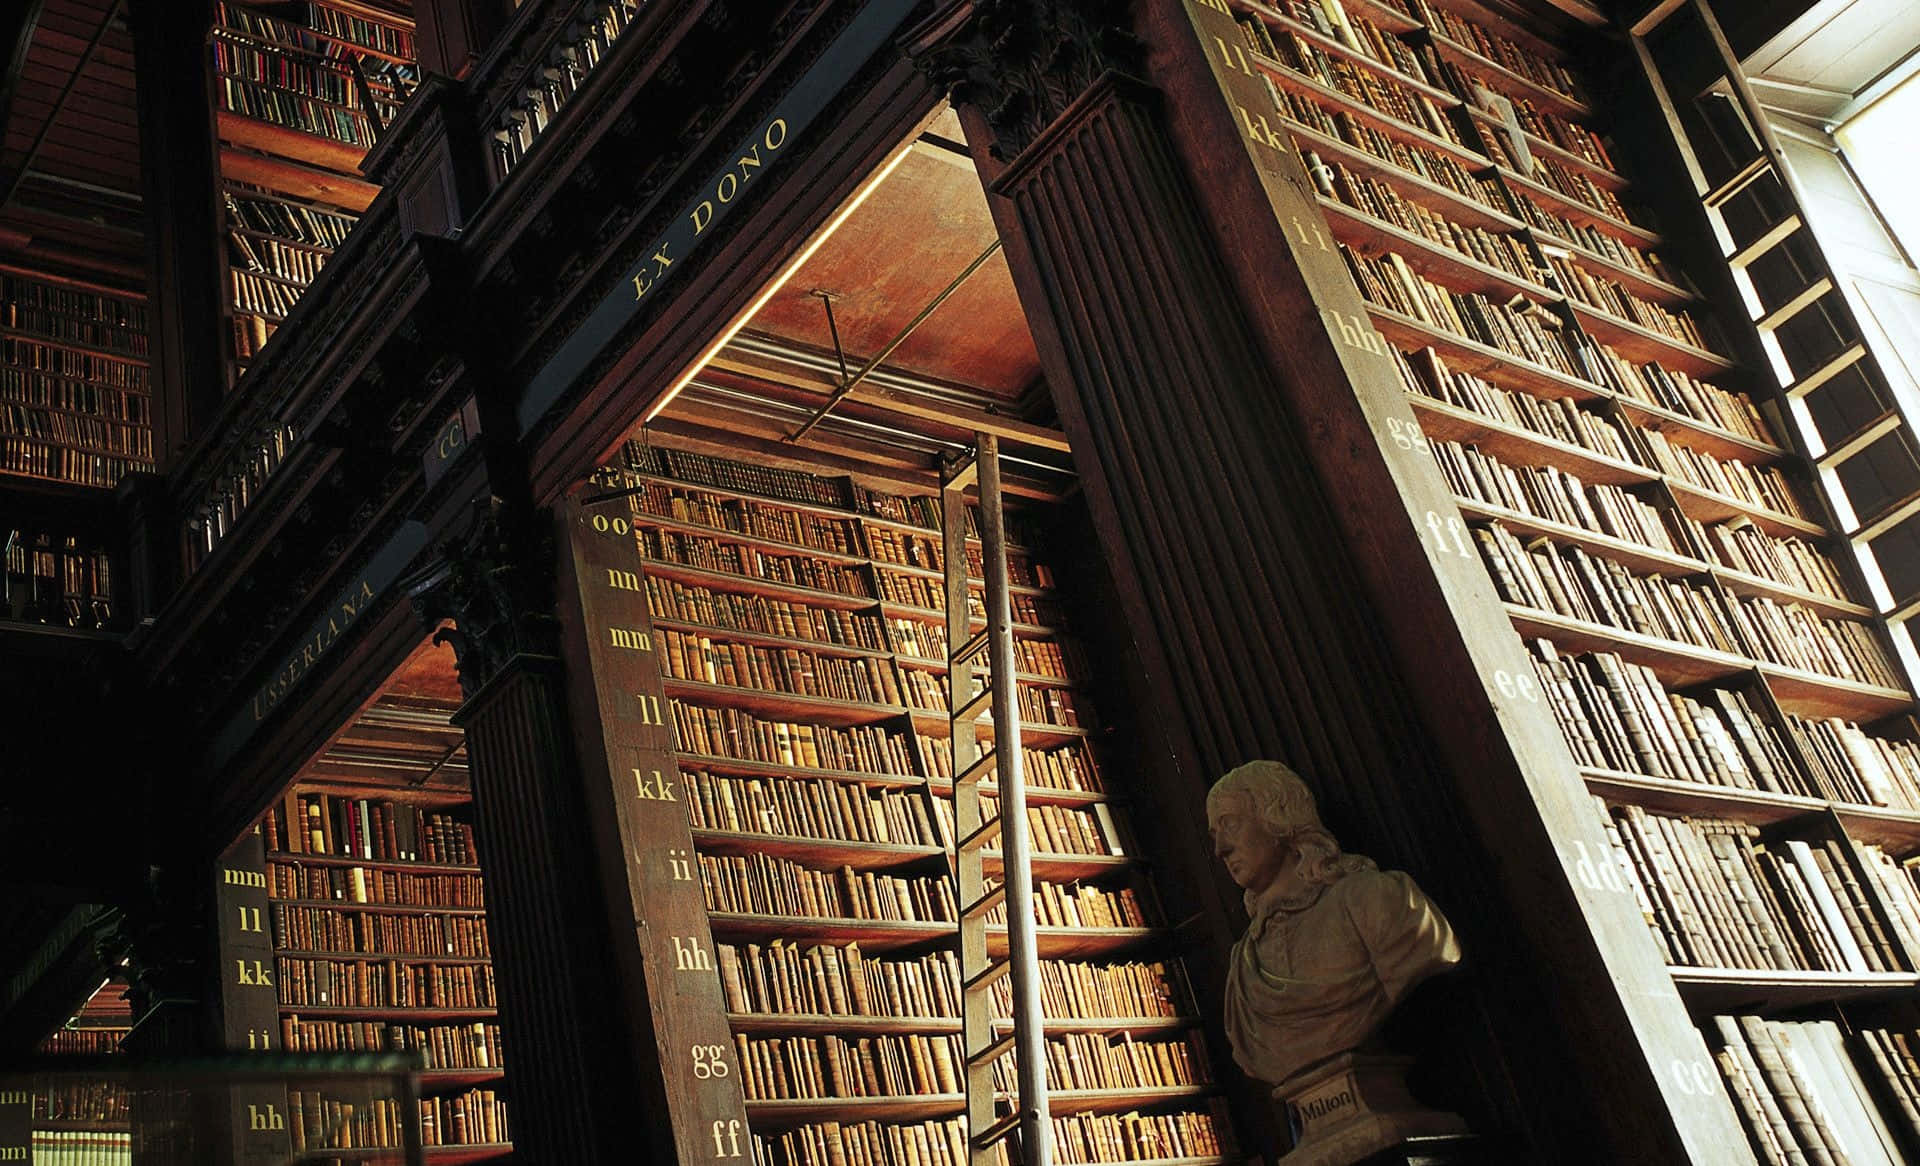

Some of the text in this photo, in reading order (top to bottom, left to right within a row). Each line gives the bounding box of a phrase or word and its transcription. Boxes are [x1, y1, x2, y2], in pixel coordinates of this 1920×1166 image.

[1214, 36, 1254, 77] ll
[1236, 105, 1288, 153] kk
[632, 118, 788, 300] EX DONO
[1292, 216, 1329, 251] ii
[1329, 310, 1384, 357] hh
[1386, 416, 1431, 455] gg
[592, 513, 629, 535] oo
[1425, 510, 1472, 559] ff
[608, 568, 640, 592] nn
[609, 627, 652, 651] mm
[1494, 669, 1538, 704] ee
[637, 694, 664, 726] ll
[631, 768, 678, 802] kk
[223, 868, 267, 889] mm
[669, 849, 693, 881] ii
[1573, 839, 1627, 893] dd
[238, 906, 262, 933] ll
[671, 936, 712, 971] hh
[236, 959, 273, 987] kk
[248, 1028, 270, 1050] ii
[691, 1044, 729, 1079] gg
[1671, 1058, 1716, 1096] cc
[248, 1104, 285, 1131] hh
[1300, 1091, 1351, 1122] Milton
[712, 1119, 742, 1158] ff
